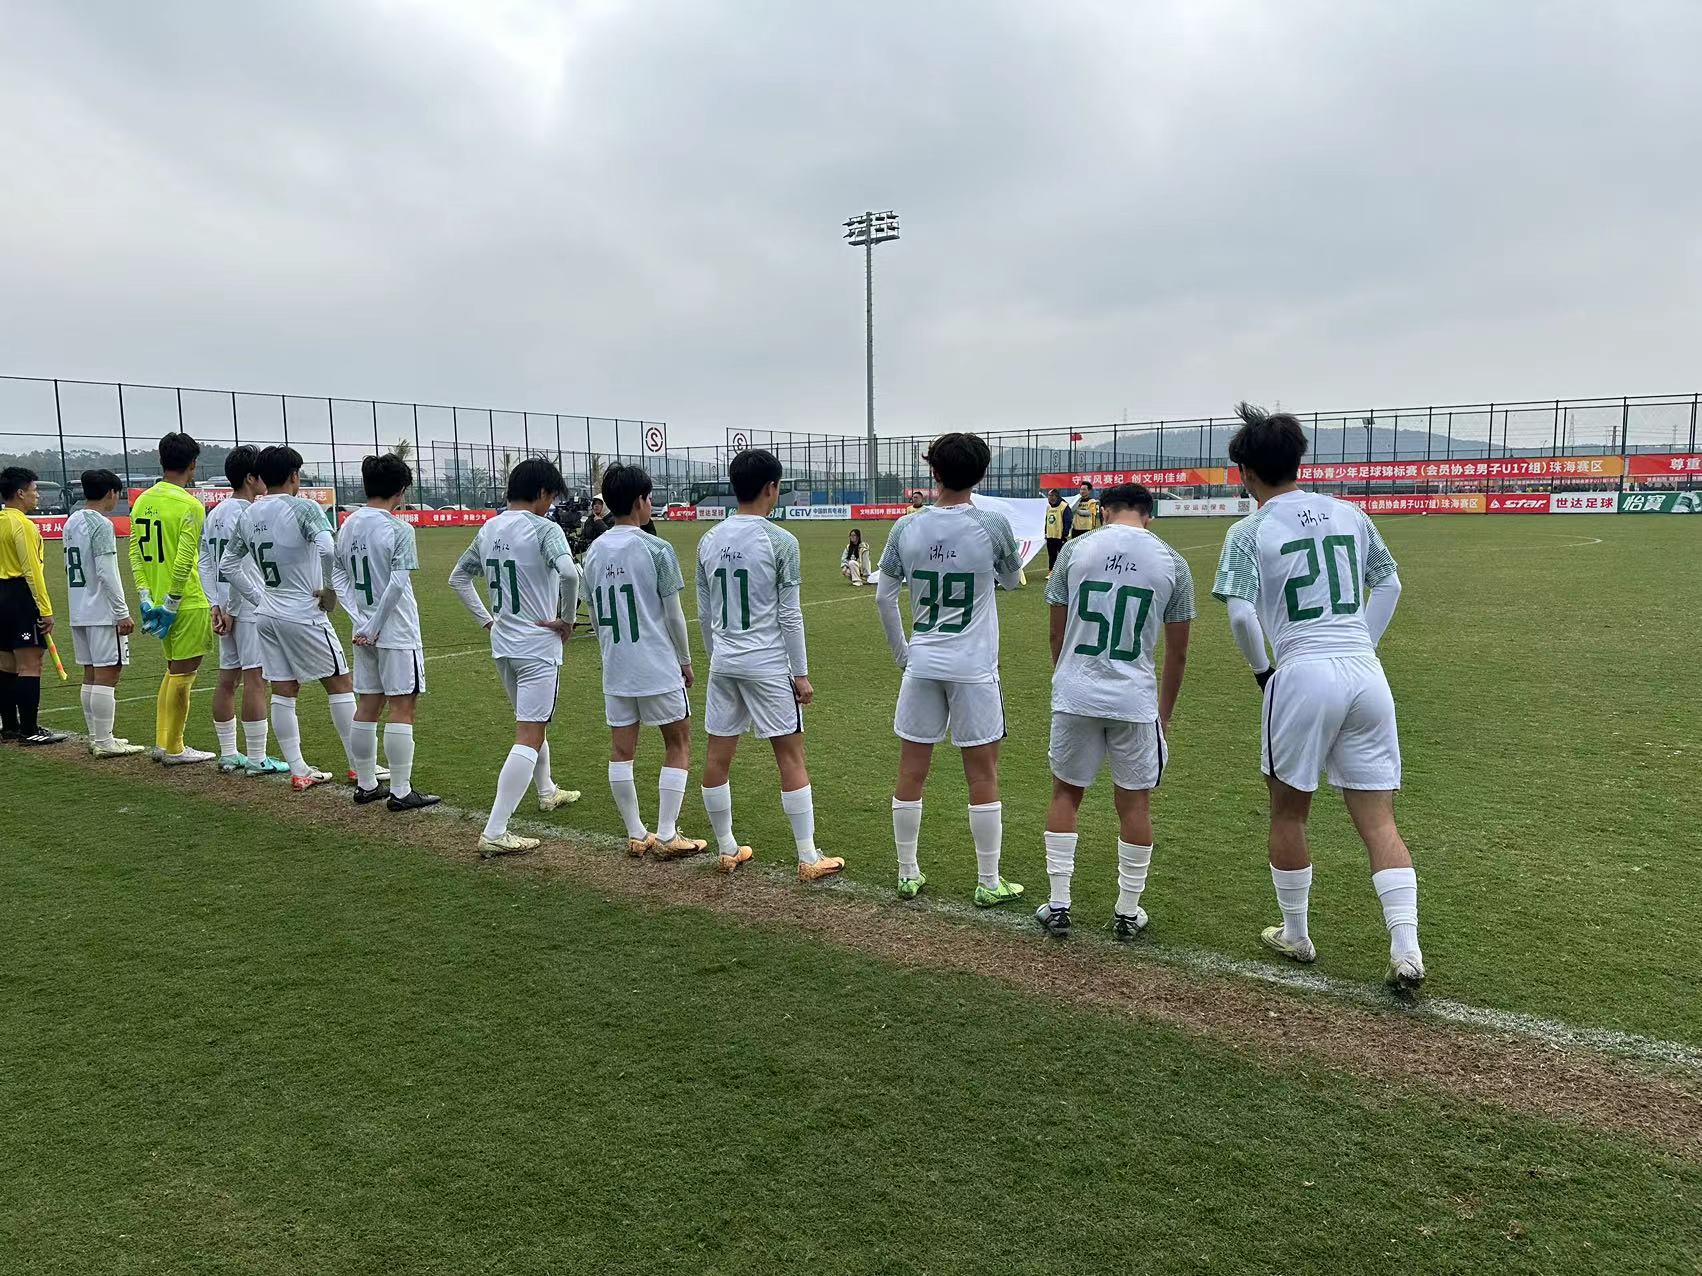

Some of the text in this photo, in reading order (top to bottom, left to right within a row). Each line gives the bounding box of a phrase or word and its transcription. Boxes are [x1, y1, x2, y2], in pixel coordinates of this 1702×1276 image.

[1131, 472, 1187, 484] 创文明佳绩
[1669, 457, 1700, 471] 尊重
[789, 508, 811, 517] CETV
[1556, 497, 1614, 509] 世达足球
[135, 517, 165, 563] 21
[249, 541, 281, 587] 16
[351, 554, 374, 606] 4
[486, 558, 520, 615] 31
[714, 567, 751, 631] 11
[911, 569, 975, 633] 39
[1279, 534, 1361, 622] 20
[595, 583, 640, 644] 41
[1074, 580, 1155, 662] 50
